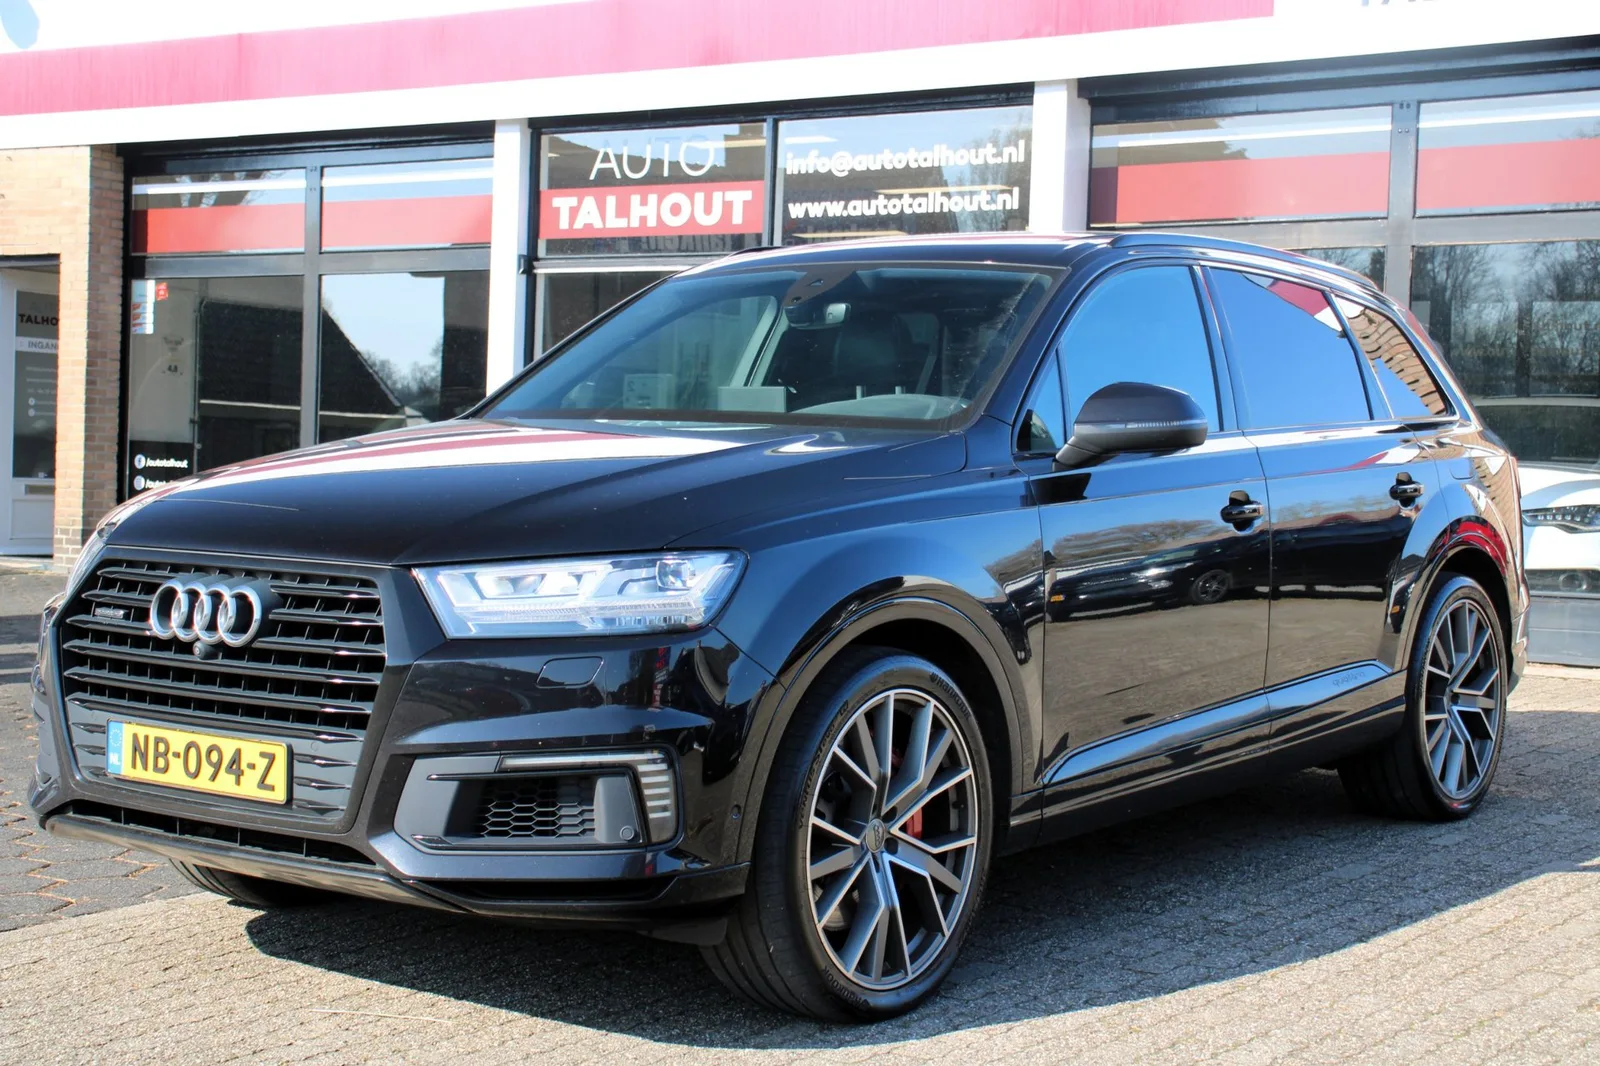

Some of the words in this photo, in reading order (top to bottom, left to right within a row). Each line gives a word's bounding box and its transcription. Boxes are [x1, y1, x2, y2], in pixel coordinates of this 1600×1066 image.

[589, 142, 715, 180] AUTO
[785, 140, 1026, 177] info@autotalhout.nl
[552, 190, 753, 229] TALHOUT
[787, 187, 1020, 219] www.autotalhout.nl
[109, 752, 121, 766] NL
[131, 733, 276, 792] NB-094-Z
